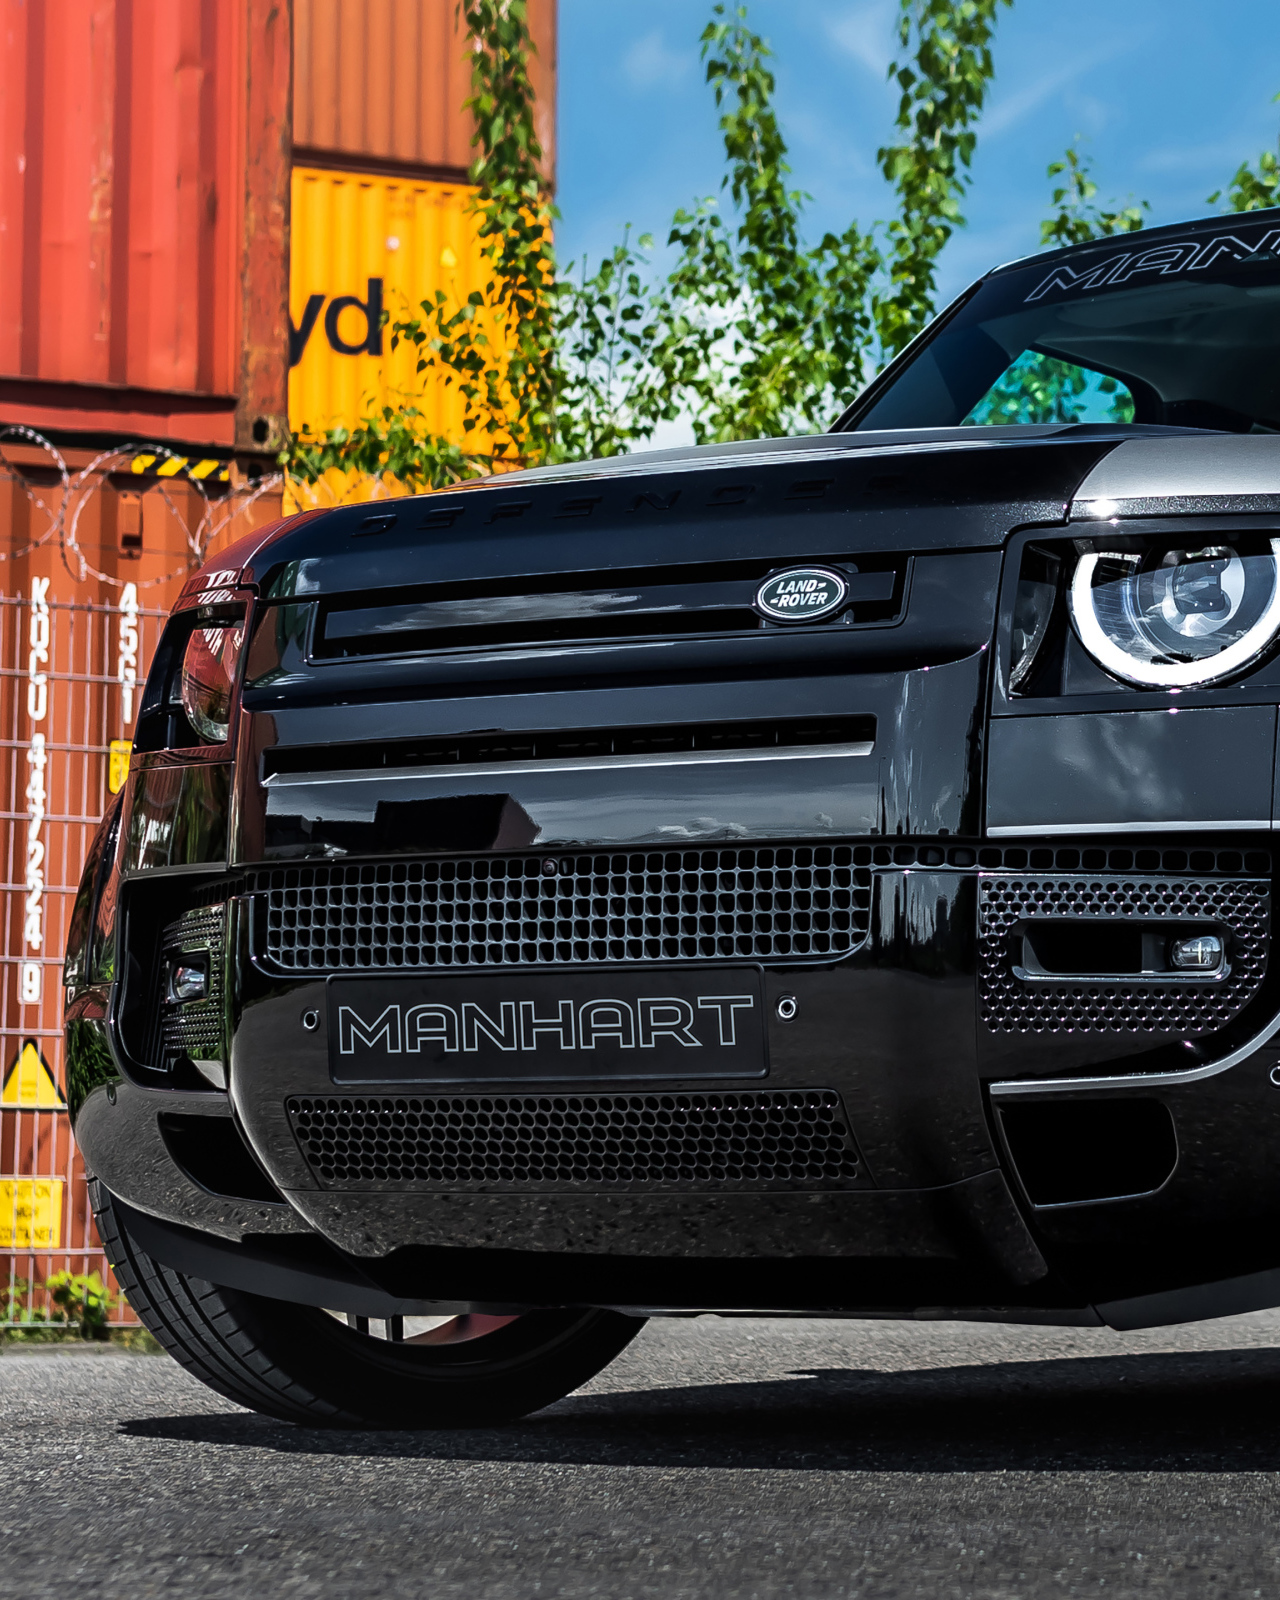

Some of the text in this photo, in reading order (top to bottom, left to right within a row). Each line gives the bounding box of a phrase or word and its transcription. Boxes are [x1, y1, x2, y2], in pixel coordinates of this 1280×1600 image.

[350, 475, 911, 538] DEFENDER
[776, 580, 818, 594] LAND
[777, 592, 828, 607] ROVER
[27, 576, 50, 721] KOCU
[22, 962, 41, 1002] 9
[339, 995, 754, 1054] MANHART
